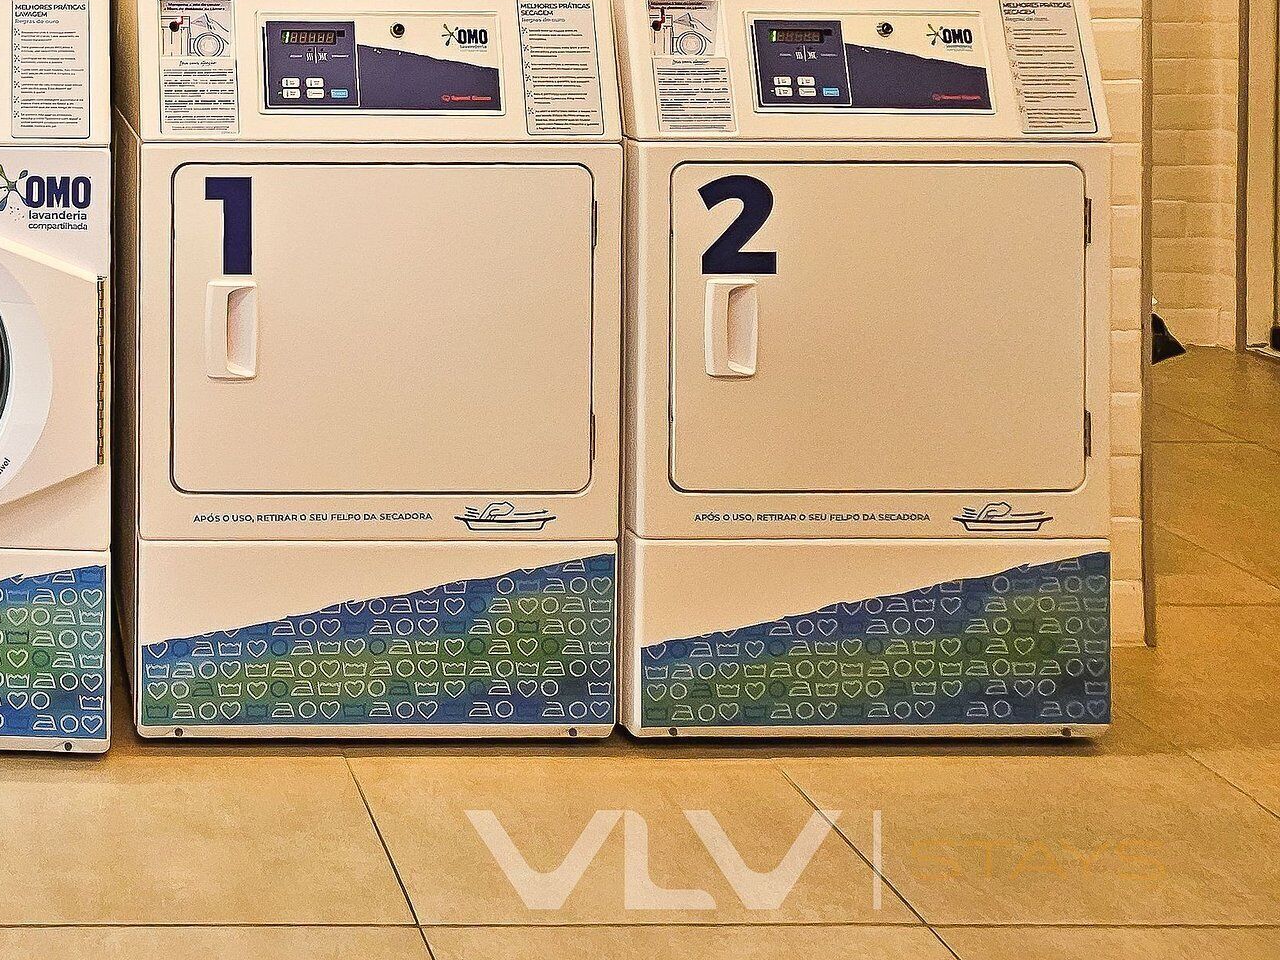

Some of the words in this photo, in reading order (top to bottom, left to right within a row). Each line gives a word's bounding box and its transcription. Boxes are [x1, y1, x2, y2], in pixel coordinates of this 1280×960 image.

[457, 28, 488, 44] OMO
[942, 28, 973, 44] OMO
[25, 176, 91, 209] OMO
[29, 210, 87, 220] lavanderia
[28, 222, 88, 231] compartilhada
[205, 176, 252, 275] 1
[697, 174, 777, 274] 2
[193, 513, 220, 523] APÓS
[232, 514, 254, 523] USO,
[257, 514, 298, 522] RETIRAR
[309, 513, 328, 521] SEU
[331, 513, 361, 521] FELPO
[379, 513, 433, 521] SECADORA
